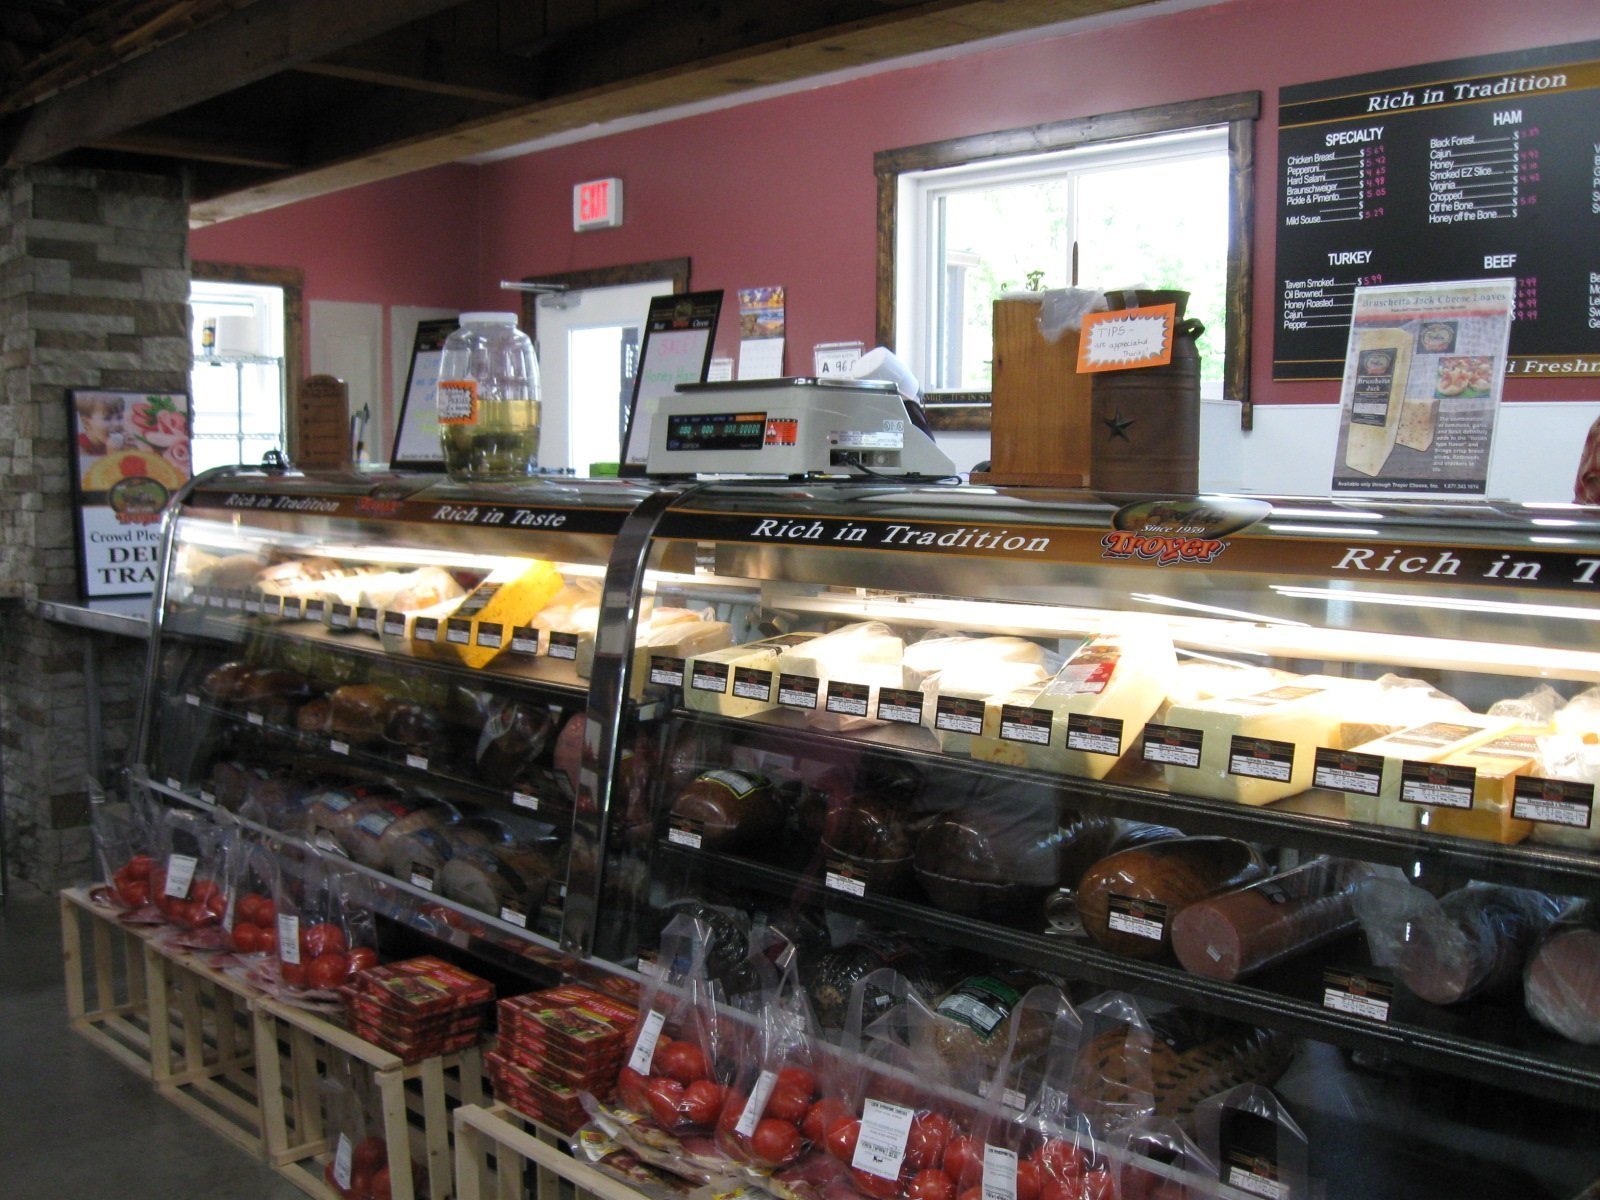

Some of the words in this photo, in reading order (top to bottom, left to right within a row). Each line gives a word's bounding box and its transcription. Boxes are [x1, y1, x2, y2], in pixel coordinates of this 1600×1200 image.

[1367, 94, 1415, 113] Rich
[1422, 89, 1444, 106] in
[1453, 74, 1568, 101] Tradition
[1493, 110, 1522, 126] HAM
[1325, 127, 1384, 147] SPECIALTY
[1430, 138, 1450, 149] Black
[1451, 136, 1475, 147] Forest
[1287, 155, 1313, 166] Chicken
[1314, 152, 1335, 162] Breast
[1430, 150, 1452, 162] Cajun
[1287, 164, 1320, 176] Pepperoni
[1430, 160, 1454, 172] Honey
[1287, 176, 1302, 186] Hard
[1304, 173, 1326, 184] Salami
[1430, 170, 1460, 181] Smoked
[1461, 168, 1472, 178] EZ
[1474, 166, 1492, 176] Slice
[1286, 182, 1338, 196] Braunschweiger
[1430, 180, 1456, 192] Virginia
[580, 181, 609, 222] EXIT
[1286, 196, 1305, 206] Pickle
[1312, 193, 1340, 203] Pimento
[1430, 190, 1463, 202] Chopped
[1429, 203, 1440, 213] Off
[1440, 202, 1452, 212] the
[1454, 201, 1474, 211] Bone
[1286, 216, 1300, 226] Mild
[1300, 215, 1321, 225] Souse
[1428, 214, 1453, 225] Honey
[1463, 211, 1476, 221] the
[1477, 210, 1498, 220] Bone
[1328, 250, 1372, 266] TURKEY
[1484, 254, 1516, 270] BEEF
[1284, 280, 1306, 290] Tavern
[1307, 277, 1334, 288] Smoked
[1284, 290, 1294, 300] Oil
[1294, 288, 1324, 298] Browned
[1284, 300, 1305, 311] Honey
[1306, 298, 1334, 308] Roasted
[1284, 310, 1304, 322] Cajun
[1098, 326, 1126, 338] TIPS
[1284, 320, 1308, 332] Pepper
[225, 493, 256, 507] Rich
[257, 496, 272, 508] in
[275, 496, 340, 512] Tradition
[432, 505, 479, 522] Rich
[482, 507, 505, 524] in
[510, 509, 567, 528] Taste
[1141, 524, 1173, 533] Since
[90, 530, 132, 544] Crowd
[750, 519, 824, 540] Rich
[834, 522, 868, 542] in
[880, 525, 1051, 552] Tradition
[1101, 530, 1225, 567] Troyer
[1331, 548, 1462, 576] Rich
[1482, 554, 1542, 580] in
